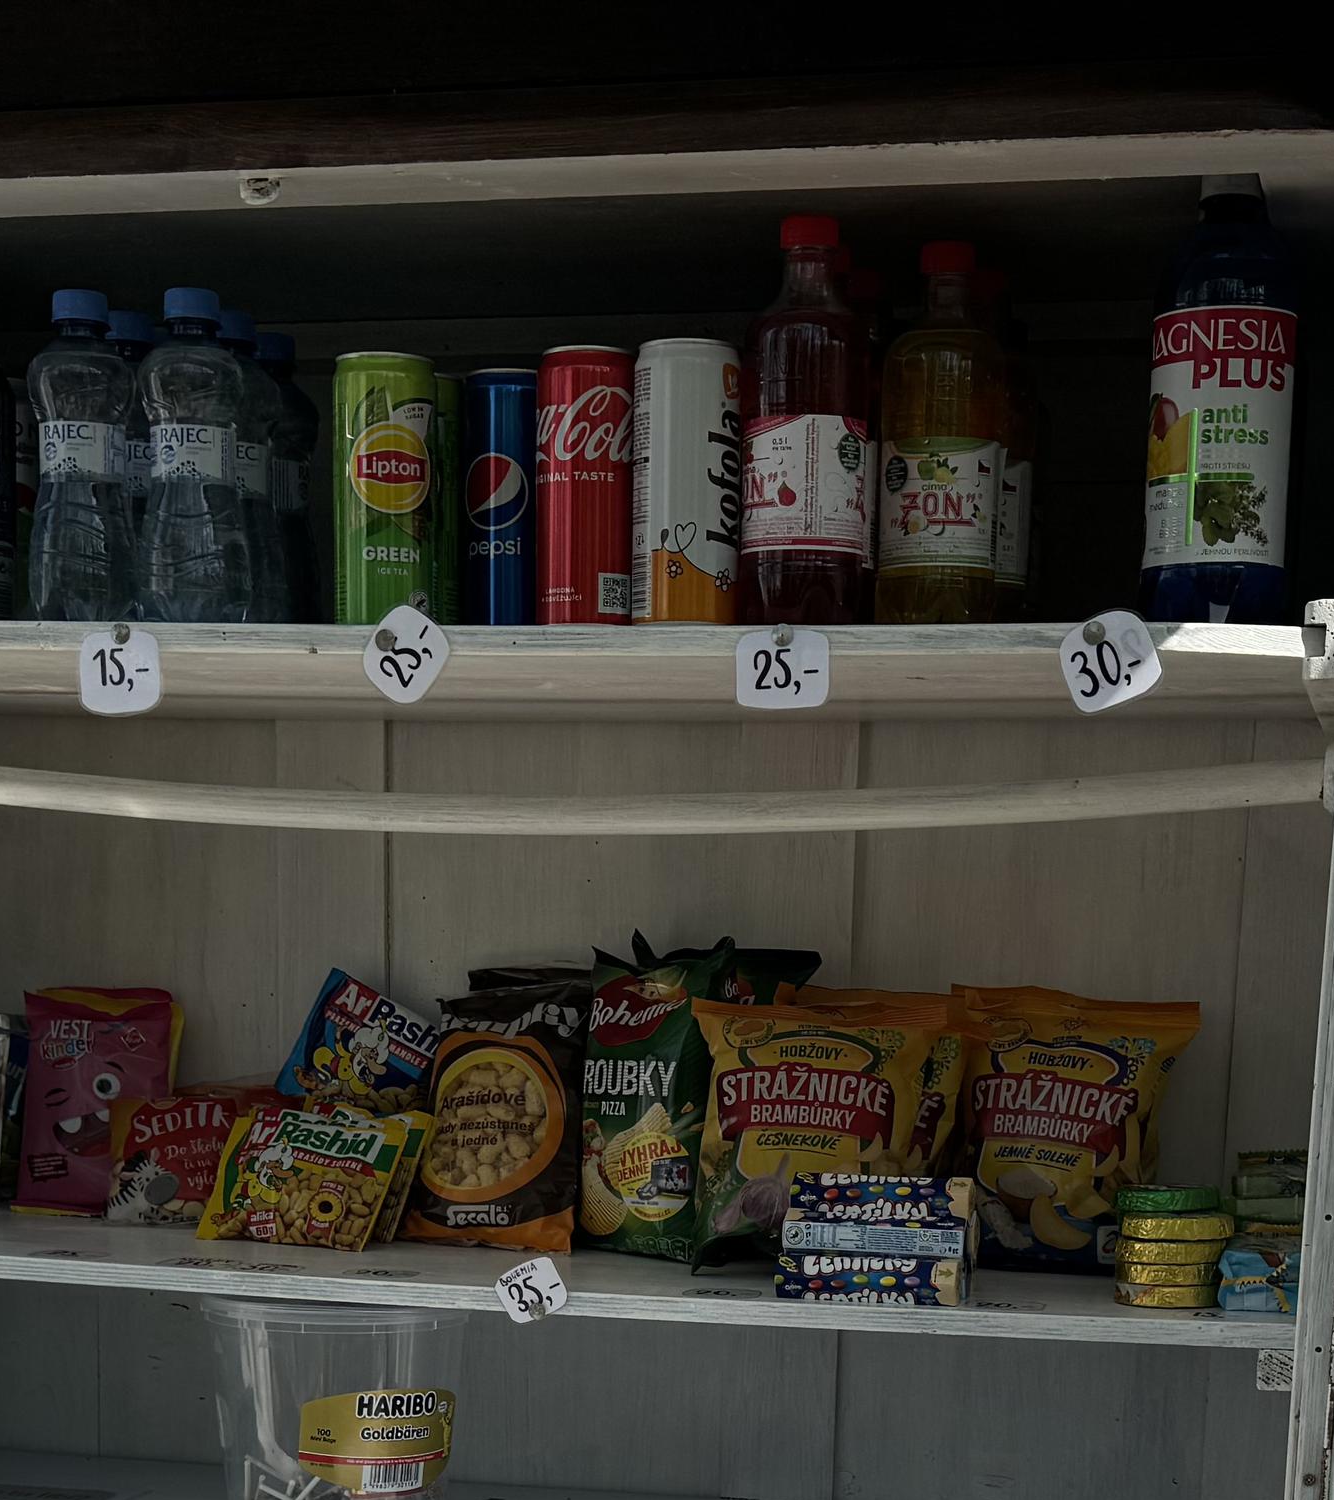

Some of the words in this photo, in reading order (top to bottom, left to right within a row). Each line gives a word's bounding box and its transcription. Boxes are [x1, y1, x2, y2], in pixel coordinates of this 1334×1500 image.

[1192, 358, 1286, 392] PLUS
[1202, 404, 1248, 424] anti
[44, 424, 93, 443] RAJEC
[160, 428, 212, 447] RAJEC
[1201, 425, 1269, 445] stress
[362, 456, 421, 478] Lipton
[573, 471, 615, 482] TASTE
[706, 410, 740, 548] kofola
[361, 546, 421, 563] GREEN
[468, 536, 522, 560] pepsi
[378, 567, 391, 576] ICE
[393, 568, 409, 576] TEA
[379, 625, 433, 688] 25,-
[92, 648, 149, 692] 15,-
[753, 648, 820, 695] 25,-
[1070, 639, 1142, 698] 30,-
[334, 983, 372, 1017] Ar
[50, 1019, 92, 1040] VEST
[42, 1038, 93, 1060] kinder
[779, 1043, 844, 1061] HOBŽOVY
[1028, 1051, 1091, 1071] HOBŽOVY
[441, 1089, 527, 1112] Arašídové
[722, 1065, 890, 1117] STRÁŽNICKÉ
[974, 1072, 1136, 1128] STRÁŽNICKÉ
[600, 1101, 626, 1116] PIZZA
[751, 1102, 856, 1130] BRAMBŮRKY
[273, 1120, 378, 1157] Rashid
[993, 1113, 1095, 1144] BRAMBŮRKY
[461, 1133, 498, 1148] jedné
[756, 1129, 843, 1151] ČESNEKOVÉ
[1035, 1149, 1083, 1167] SOLENÉ
[446, 1204, 510, 1226] Secalo
[508, 1275, 560, 1312] 35,-
[357, 1392, 437, 1418] HARIBO
[360, 1426, 430, 1441] Goldbären
